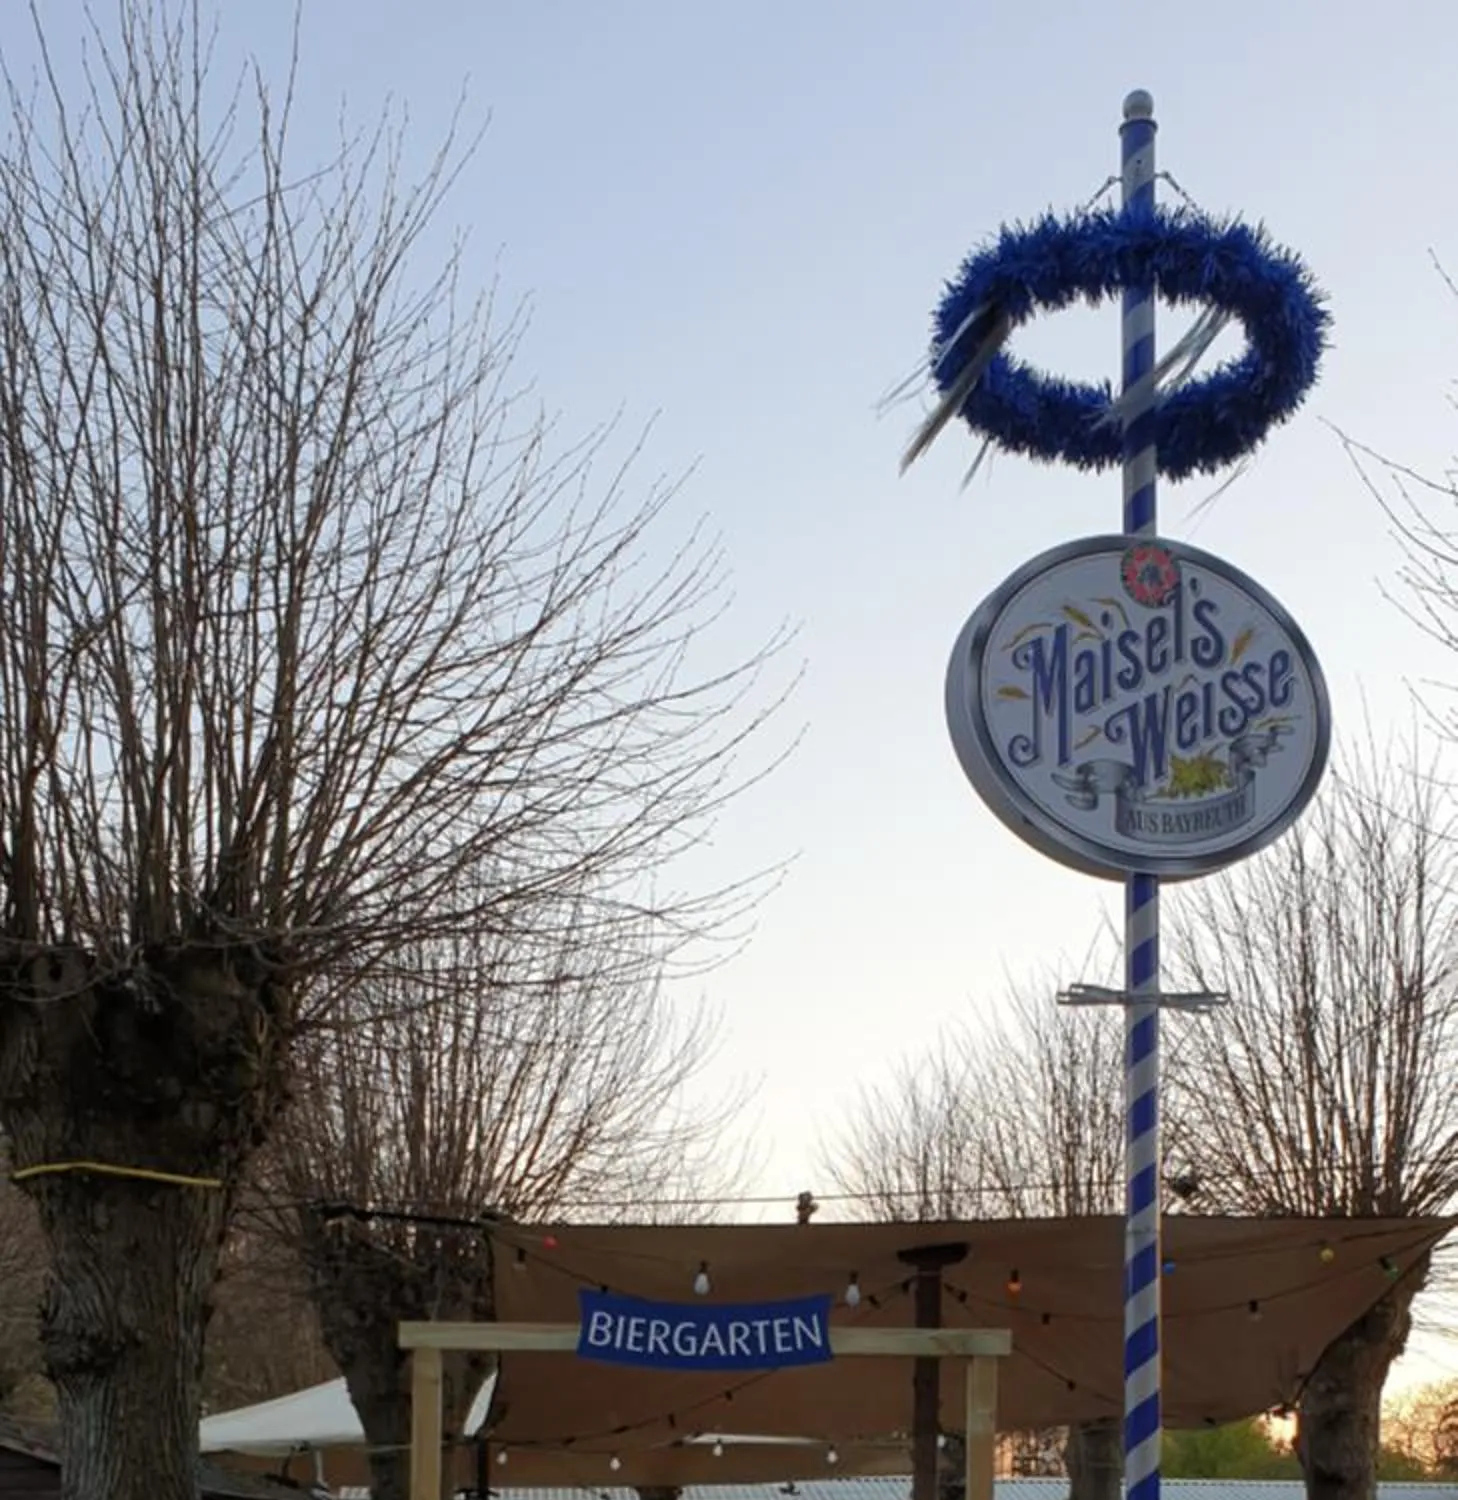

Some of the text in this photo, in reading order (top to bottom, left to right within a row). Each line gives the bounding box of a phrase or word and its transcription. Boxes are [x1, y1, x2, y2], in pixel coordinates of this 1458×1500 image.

[1008, 577, 1224, 768] Maisel's
[1127, 794, 1247, 833] AUS BAYREUTH
[587, 1311, 823, 1357] BIERGARTEN
